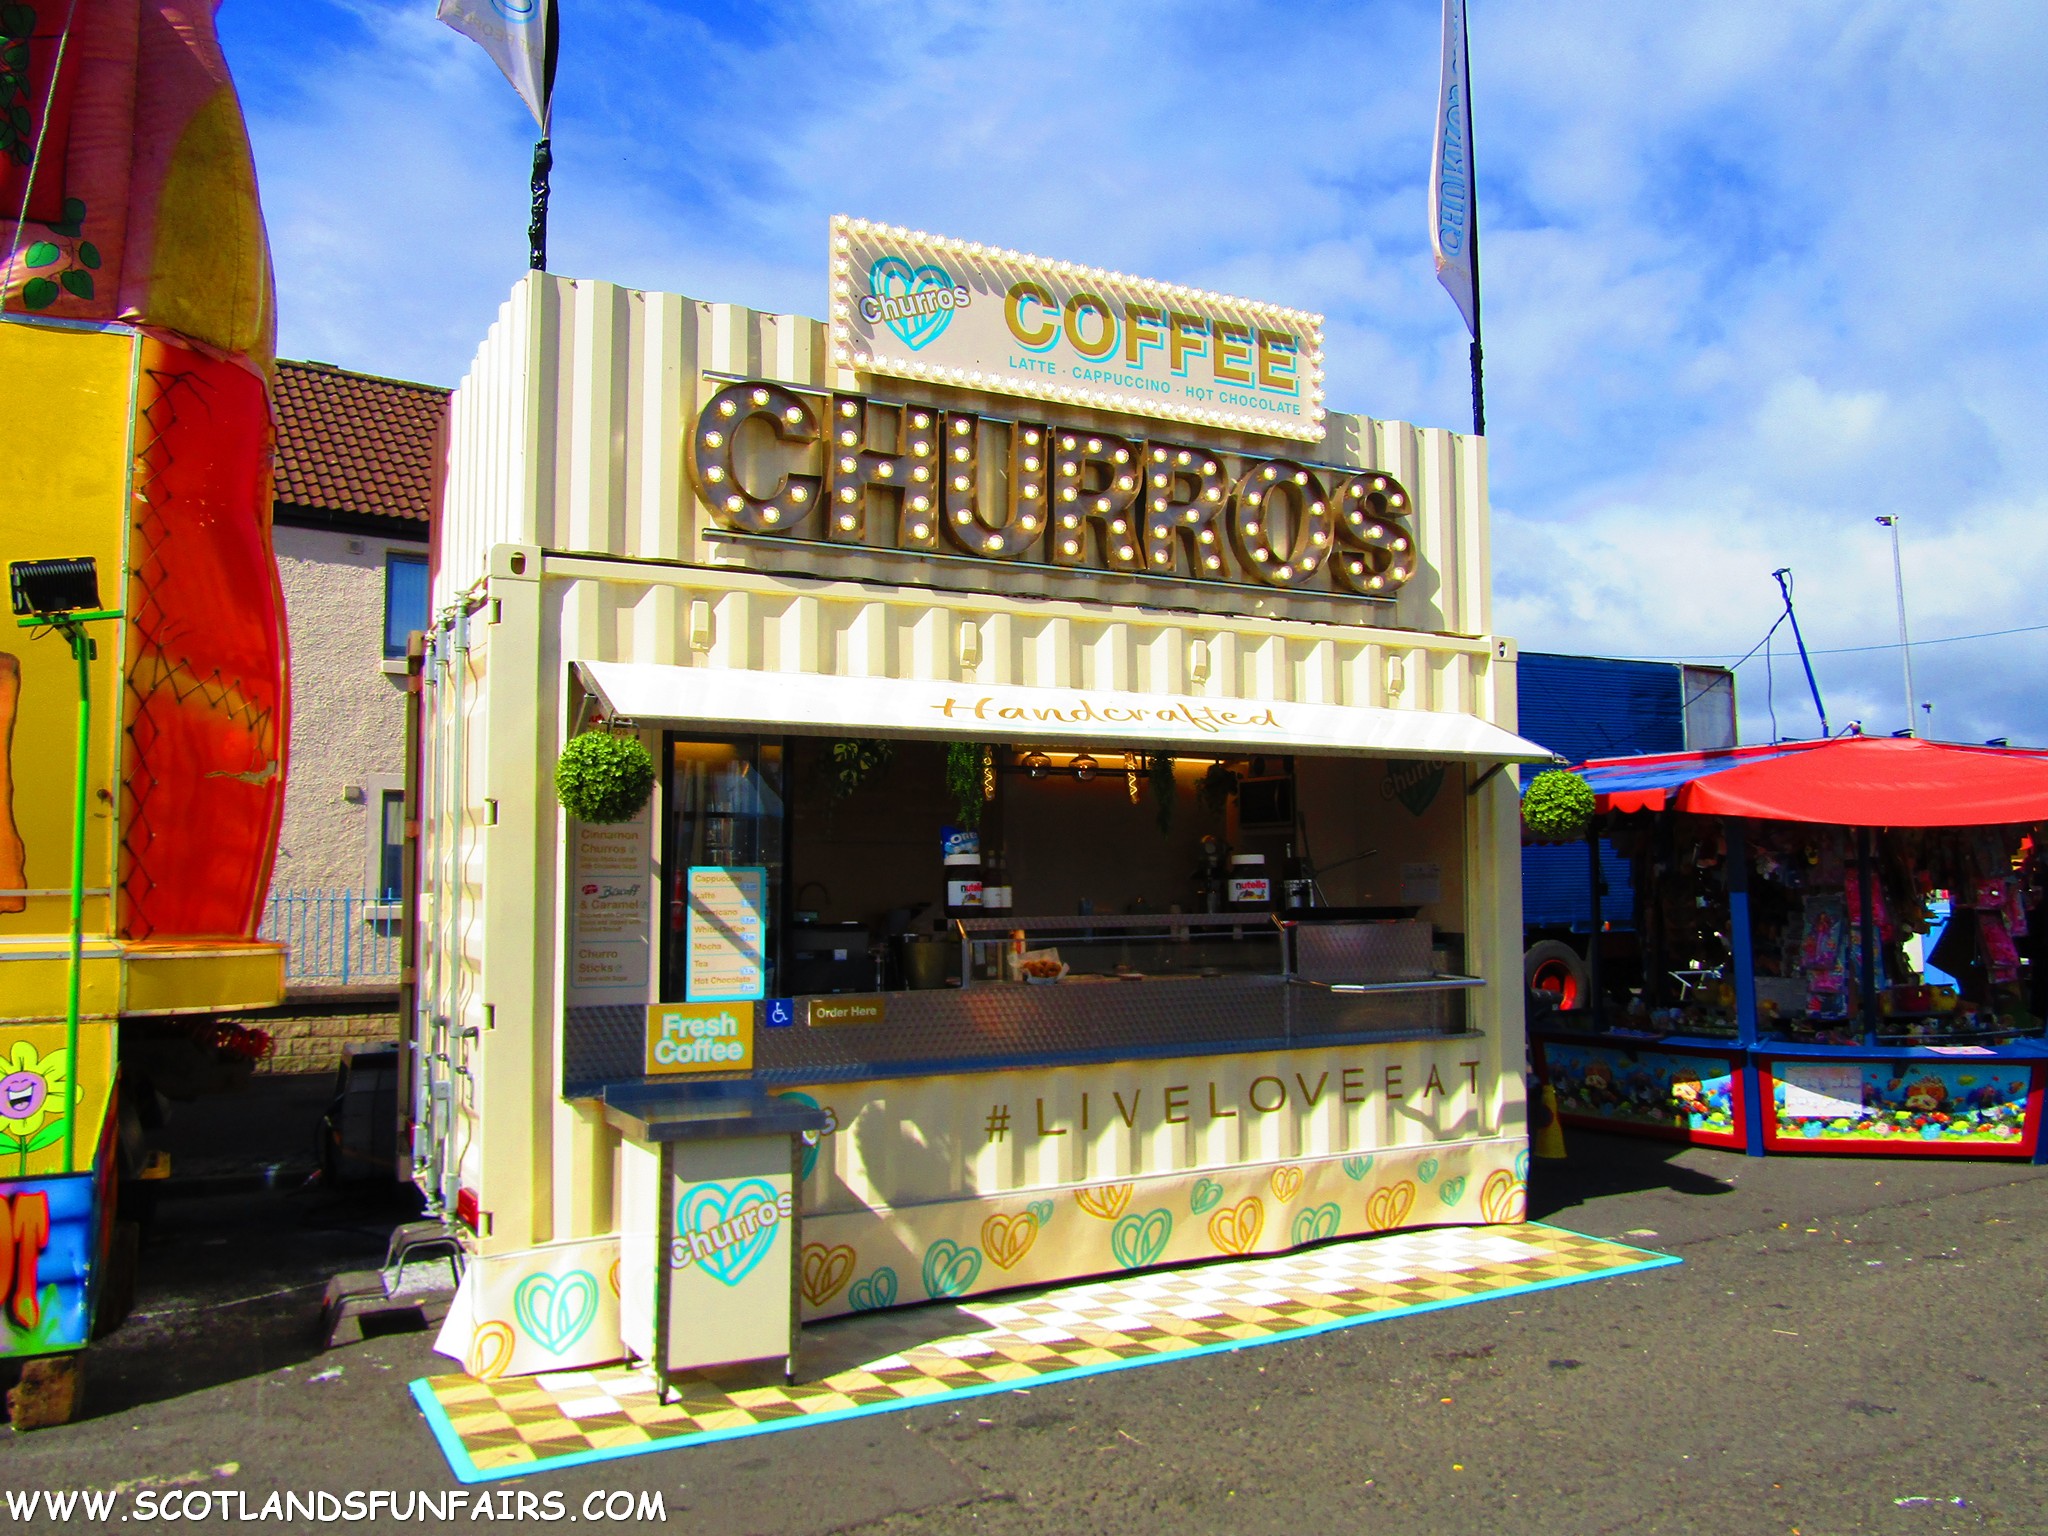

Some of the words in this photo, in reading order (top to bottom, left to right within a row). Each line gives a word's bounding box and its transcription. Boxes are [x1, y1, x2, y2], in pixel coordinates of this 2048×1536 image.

[858, 285, 973, 324] Churros
[1004, 281, 1300, 398] COFFEE
[1009, 355, 1056, 375] LATTE
[1072, 366, 1171, 394] CAPPUCCINO
[1185, 386, 1213, 402] HOT
[1219, 392, 1301, 416] CHOCOLATE
[687, 382, 1418, 595] CHURROS
[930, 697, 1285, 732] Handcrafted
[581, 829, 639, 840] Cinnamon
[581, 844, 626, 854] Churros
[695, 874, 743, 884] Cappuccino
[1235, 880, 1267, 891] nutella
[695, 892, 715, 900] Latte
[591, 900, 639, 910] Caramel
[694, 925, 718, 934] White
[694, 942, 721, 951] Mocha
[578, 949, 618, 959] Churro
[578, 963, 613, 973] Sticks
[694, 959, 708, 968] Tea
[694, 977, 709, 985] Hot
[711, 975, 751, 985] Chocolate
[816, 1007, 848, 1019] Order
[850, 1006, 877, 1017] Here
[661, 1011, 739, 1039] Fresh
[653, 1037, 745, 1065] Coffee
[984, 1060, 1481, 1142] #LIVELOVEEAT
